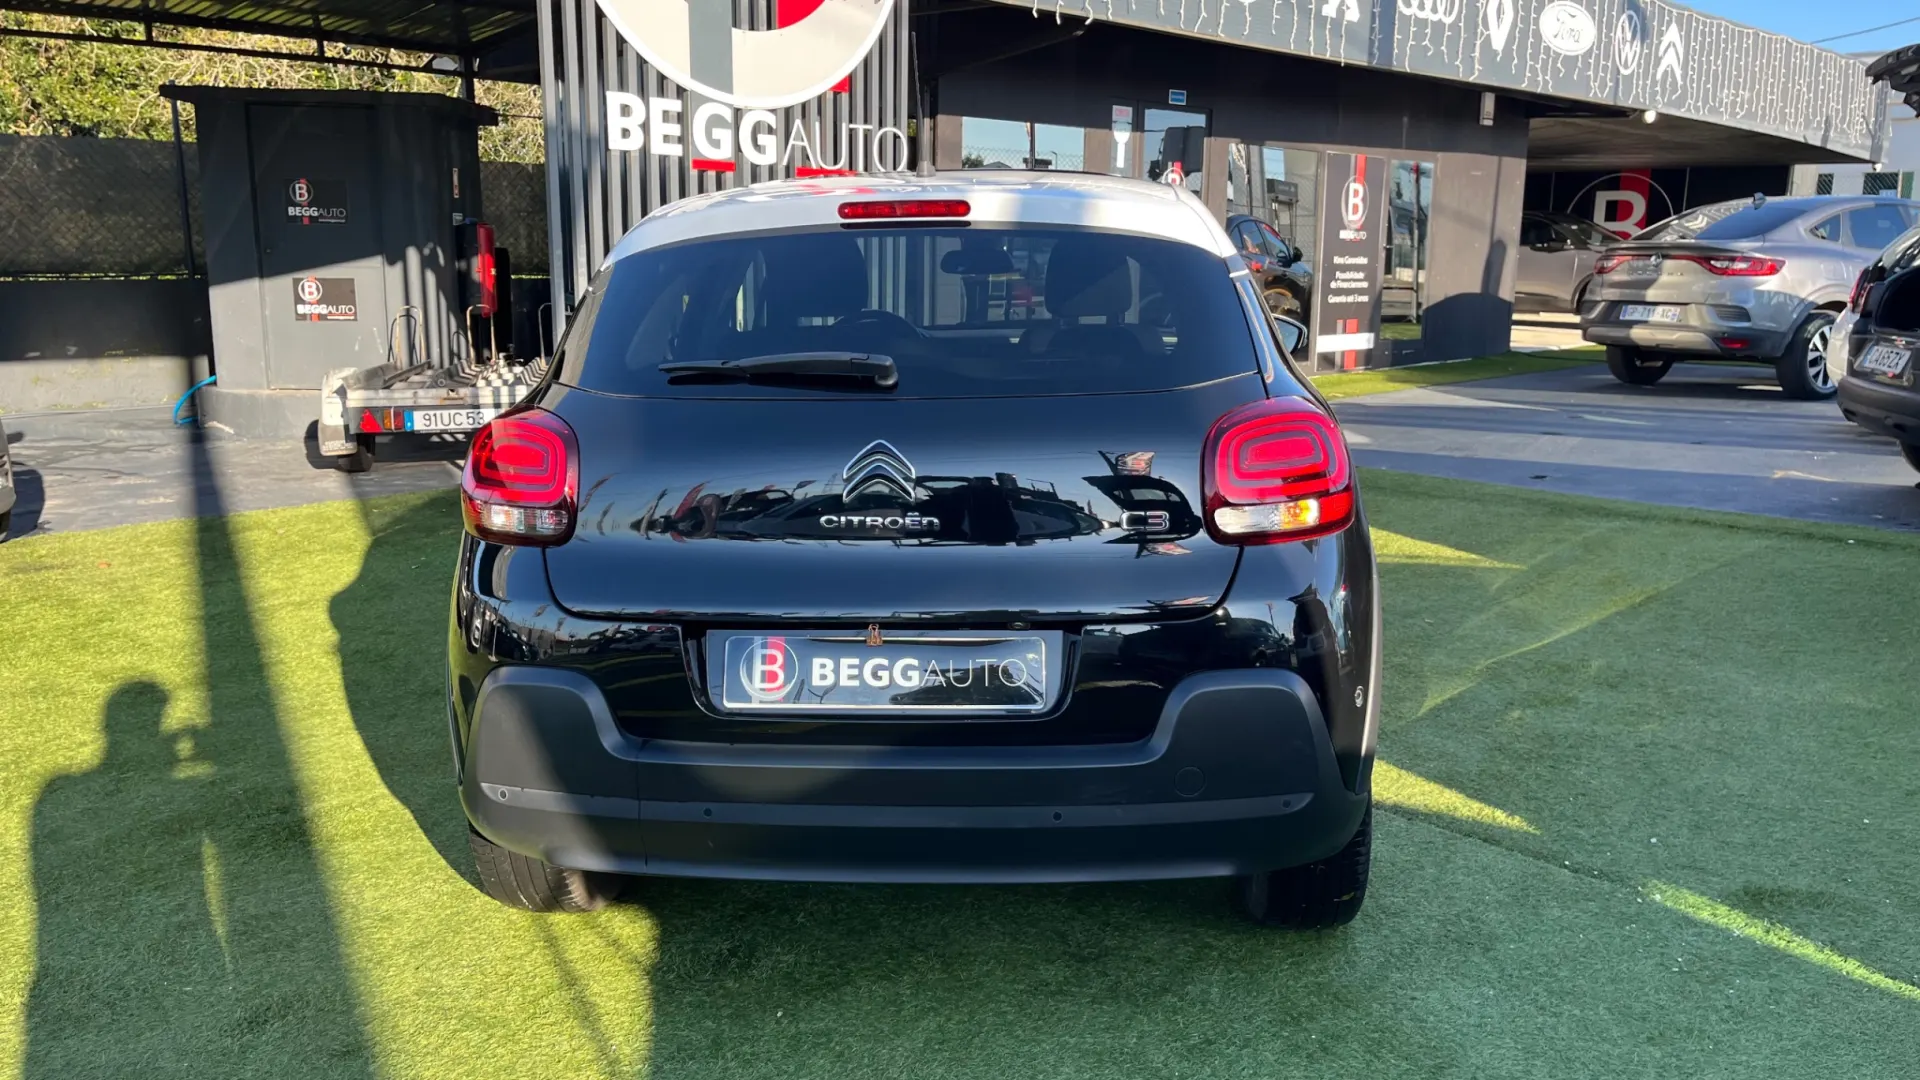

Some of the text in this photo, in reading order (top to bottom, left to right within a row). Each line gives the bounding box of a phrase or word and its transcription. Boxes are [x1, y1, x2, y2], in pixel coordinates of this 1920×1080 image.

[605, 90, 909, 172] BEGGAUTO
[288, 206, 346, 217] BEGGAUTO
[1347, 182, 1364, 222] B
[296, 304, 355, 315] BEGGAUTO
[1119, 511, 1170, 532] C3
[811, 657, 1028, 688] BEGGAUTO
